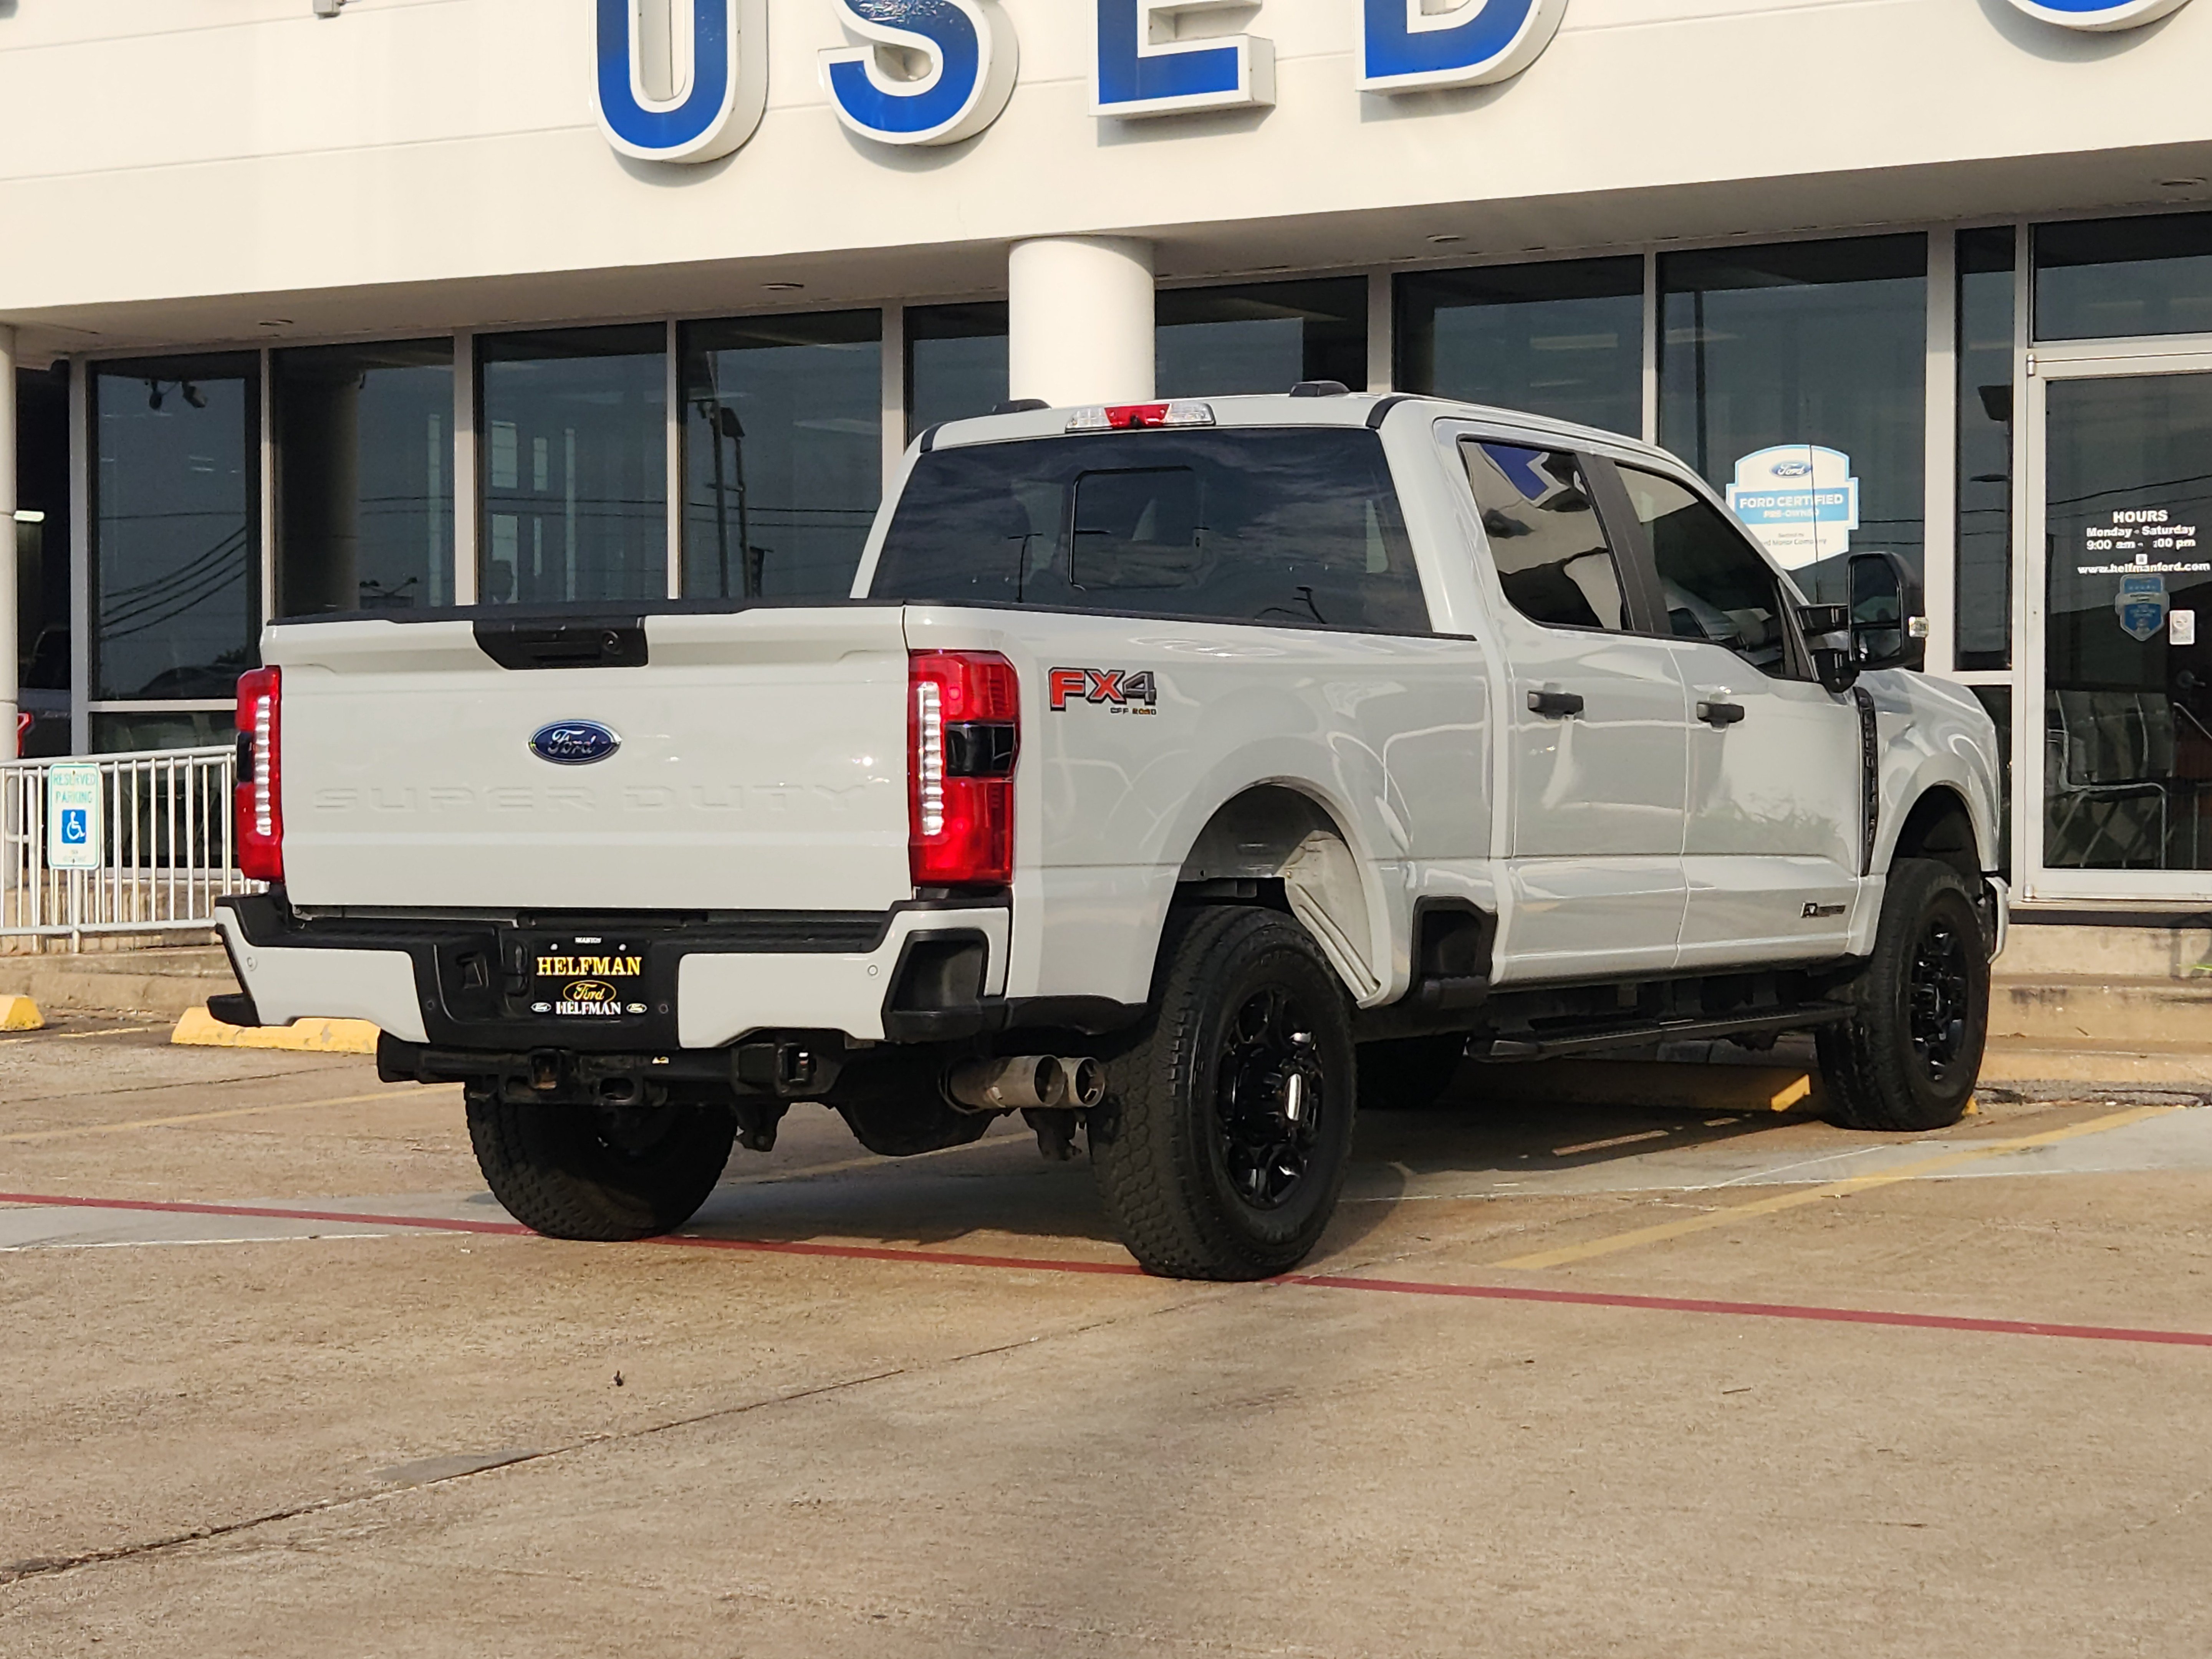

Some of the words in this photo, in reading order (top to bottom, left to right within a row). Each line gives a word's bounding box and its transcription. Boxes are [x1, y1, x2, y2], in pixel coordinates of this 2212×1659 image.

[1777, 463, 1805, 475] Ford
[1739, 497, 1775, 509] FORD
[1777, 493, 1844, 507] CERTIFIED
[2113, 510, 2169, 523] HOURS
[2086, 527, 2133, 538] Monday
[2141, 525, 2196, 536] Saturday
[2086, 540, 2112, 550] 9:00
[2115, 541, 2136, 549] am
[2176, 539, 2196, 550] pm
[1048, 667, 1157, 712] FX4
[547, 729, 597, 754] Ford
[54, 773, 96, 785] RESERVED
[56, 791, 92, 803] PARKING
[313, 785, 596, 813] SUPER
[623, 784, 866, 811] DUTY
[536, 957, 642, 976] HELFMAN
[573, 983, 605, 1000] Ford
[556, 1001, 621, 1015] HELFMAN
